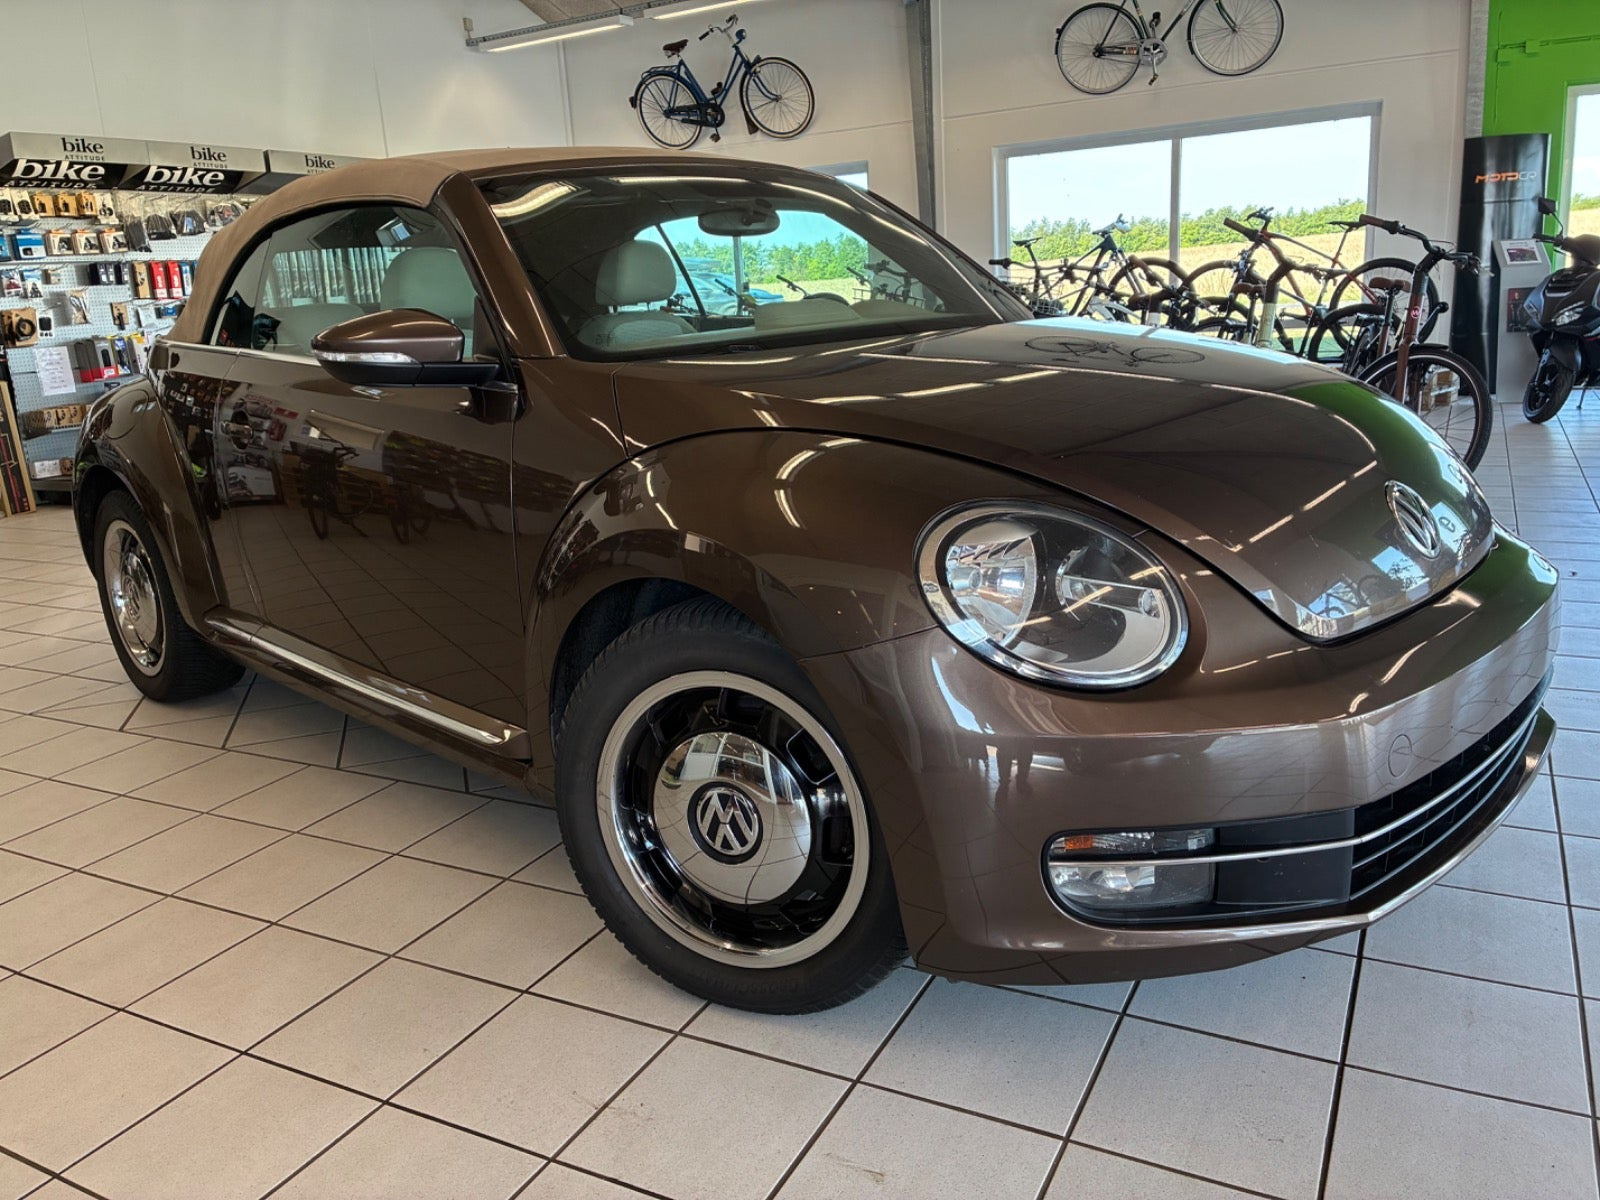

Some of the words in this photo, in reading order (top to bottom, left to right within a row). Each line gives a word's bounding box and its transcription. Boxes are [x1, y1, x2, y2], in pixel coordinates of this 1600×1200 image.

[61, 137, 104, 154] bike
[190, 146, 227, 161] bike
[64, 154, 105, 162] ATTITUDE
[304, 154, 336, 168] bike
[11, 159, 105, 181] bike
[143, 165, 224, 187] bike
[697, 787, 758, 855] VW
